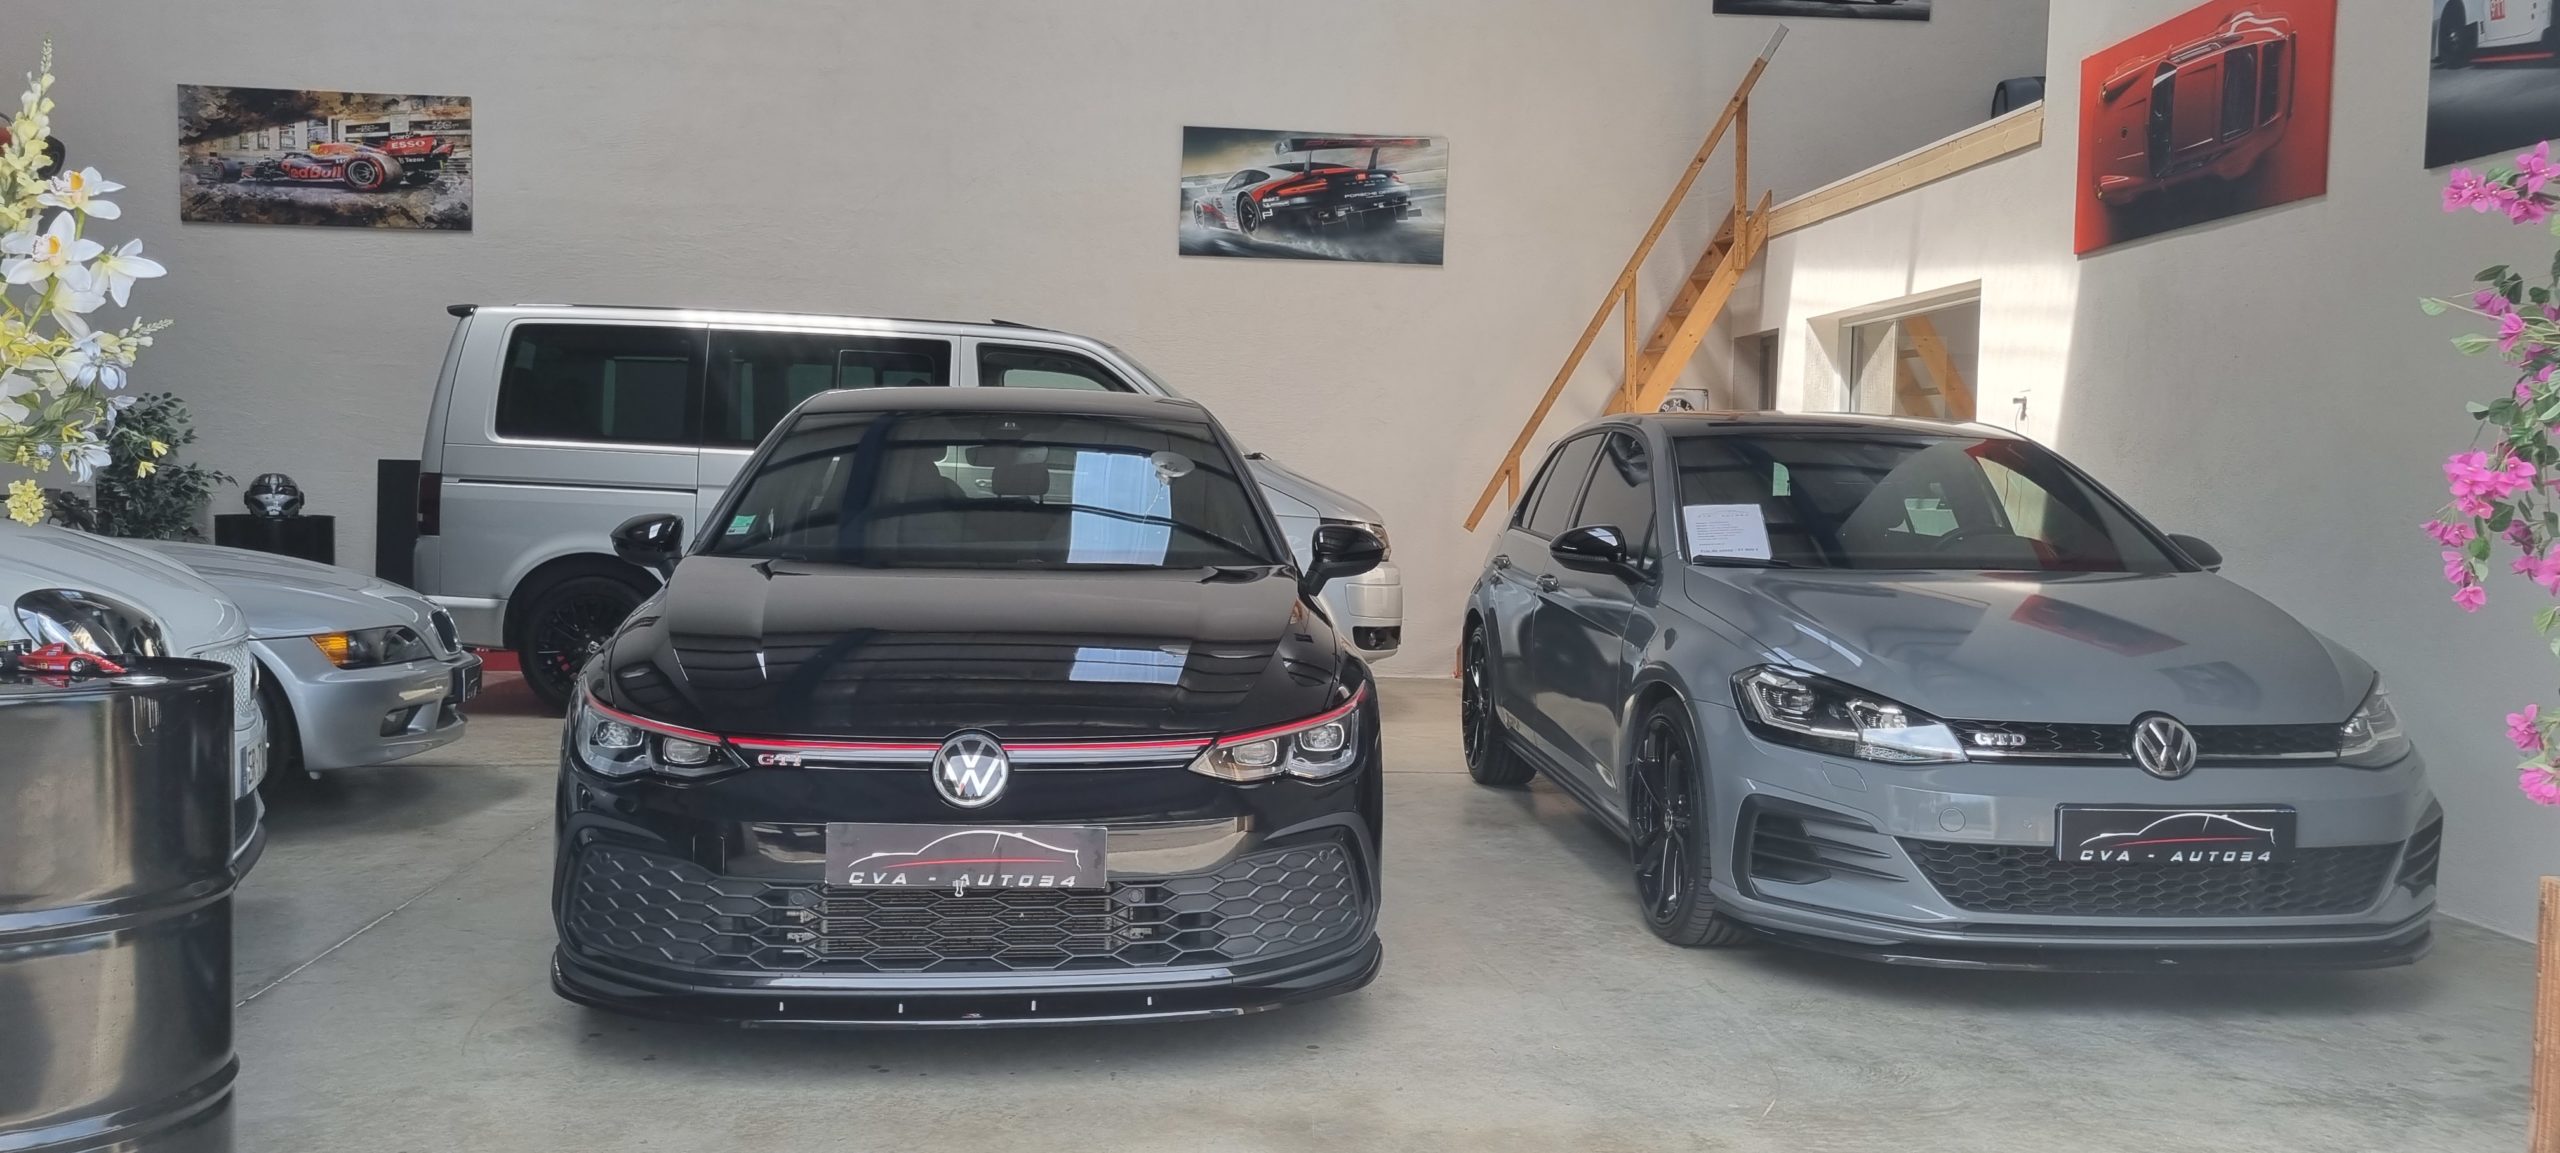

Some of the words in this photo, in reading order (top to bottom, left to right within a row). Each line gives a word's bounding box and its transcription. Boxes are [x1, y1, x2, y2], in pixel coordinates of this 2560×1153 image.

[391, 140, 425, 149] ESSO
[1974, 732, 2026, 746] GTD
[757, 753, 801, 767] GTI
[2080, 850, 2130, 862] CVA
[2169, 850, 2271, 863] AUTO34
[848, 871, 908, 885] CVA
